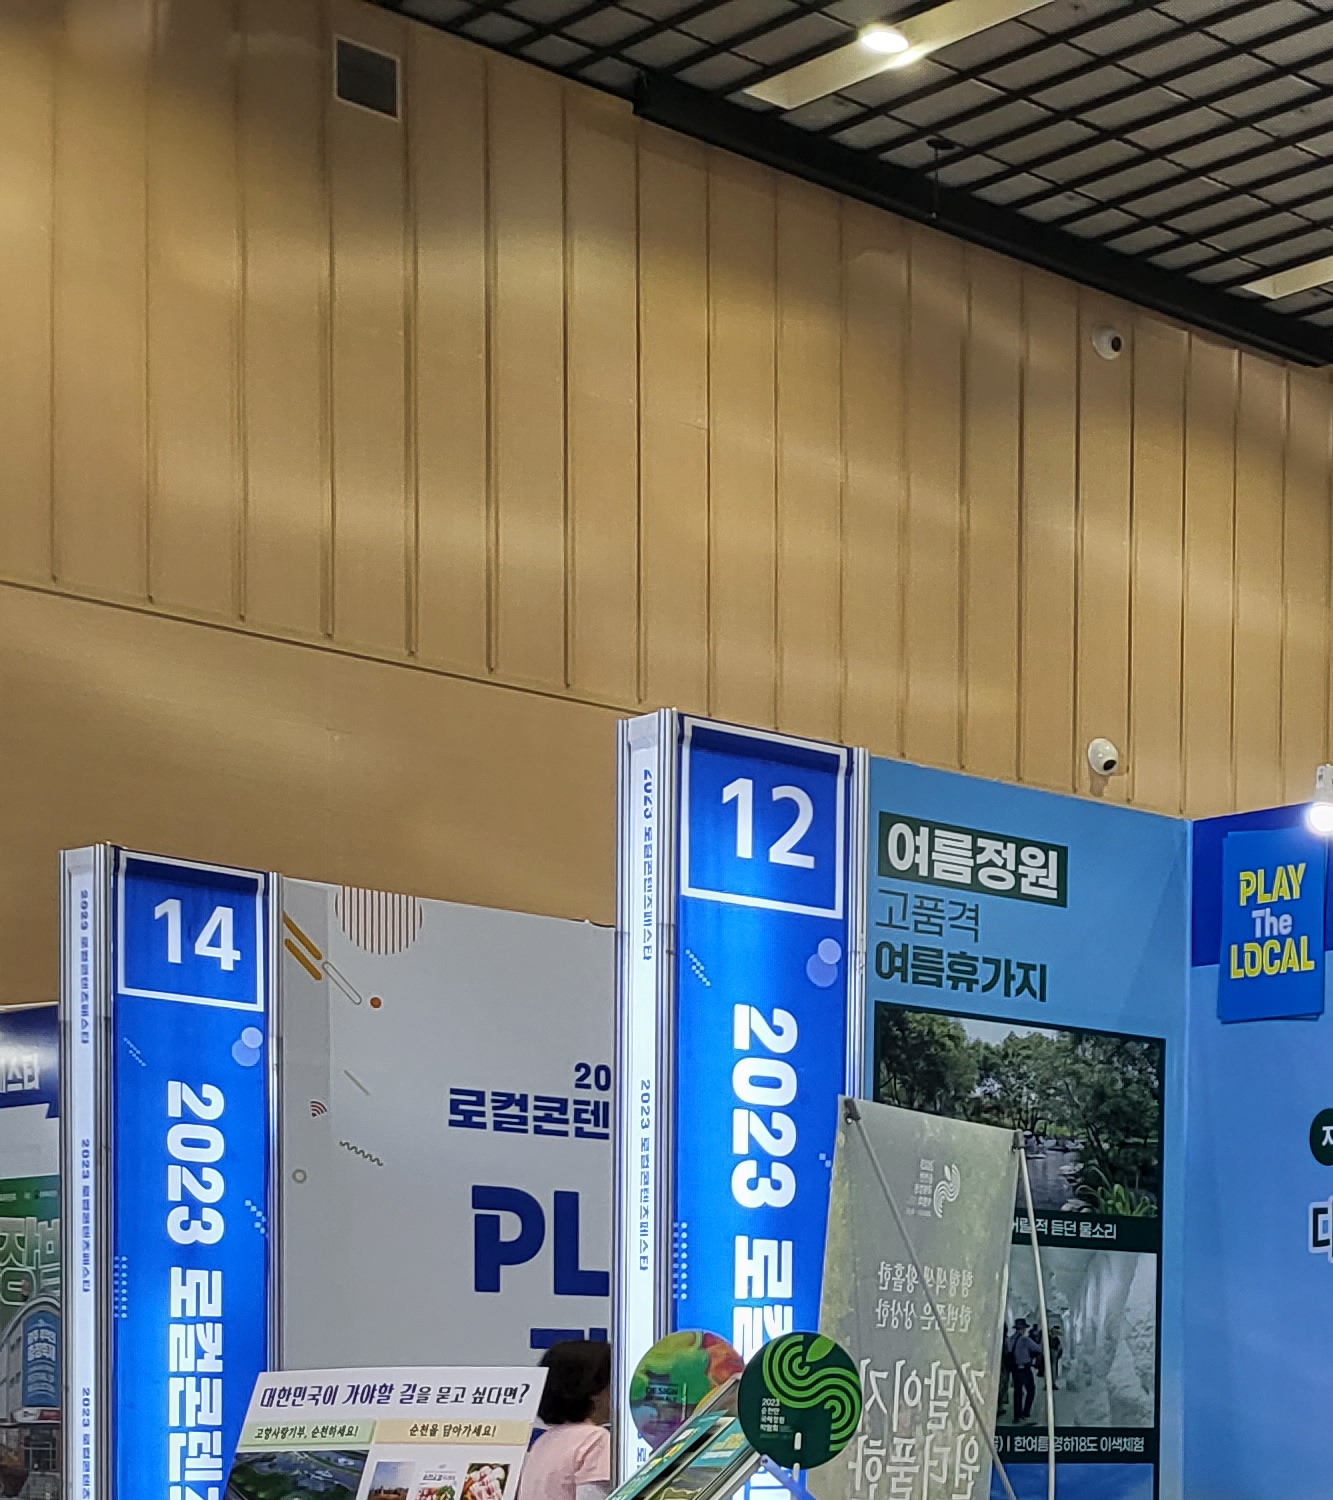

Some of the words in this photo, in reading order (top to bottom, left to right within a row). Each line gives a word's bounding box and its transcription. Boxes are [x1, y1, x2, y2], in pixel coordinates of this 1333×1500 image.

[643, 769, 653, 819] 2023
[721, 777, 815, 869] 12
[887, 822, 1058, 899] 여름정원
[1239, 862, 1306, 906] PLAY
[153, 898, 241, 971] 14
[875, 889, 980, 943] 고품격
[1252, 907, 1292, 938] The
[875, 940, 1047, 1002] 여름휴가지
[1230, 935, 1315, 979] LOCAL
[640, 1078, 651, 1130] 2023
[731, 1004, 798, 1210] 2023
[81, 1138, 91, 1180] 2023
[166, 1080, 225, 1245] 2023
[640, 1137, 651, 1271] 로컬콘텐츠페스타
[82, 1185, 91, 1293] 로컬콘텐츠페스타
[1051, 1219, 1077, 1236] 듣던
[1080, 1222, 1117, 1240] 물소리
[81, 1387, 91, 1428] 2023
[260, 1384, 339, 1408] 대한민국이
[342, 1383, 395, 1405] 가야할
[399, 1383, 431, 1405] 길을
[435, 1386, 466, 1405] 묻고
[471, 1383, 531, 1405] 싶다면?
[311, 1425, 358, 1438] 순천하세요!
[409, 1423, 439, 1437] 순천을
[1014, 1437, 1048, 1451] 한여름
[1100, 1437, 1144, 1453] 이색체험
